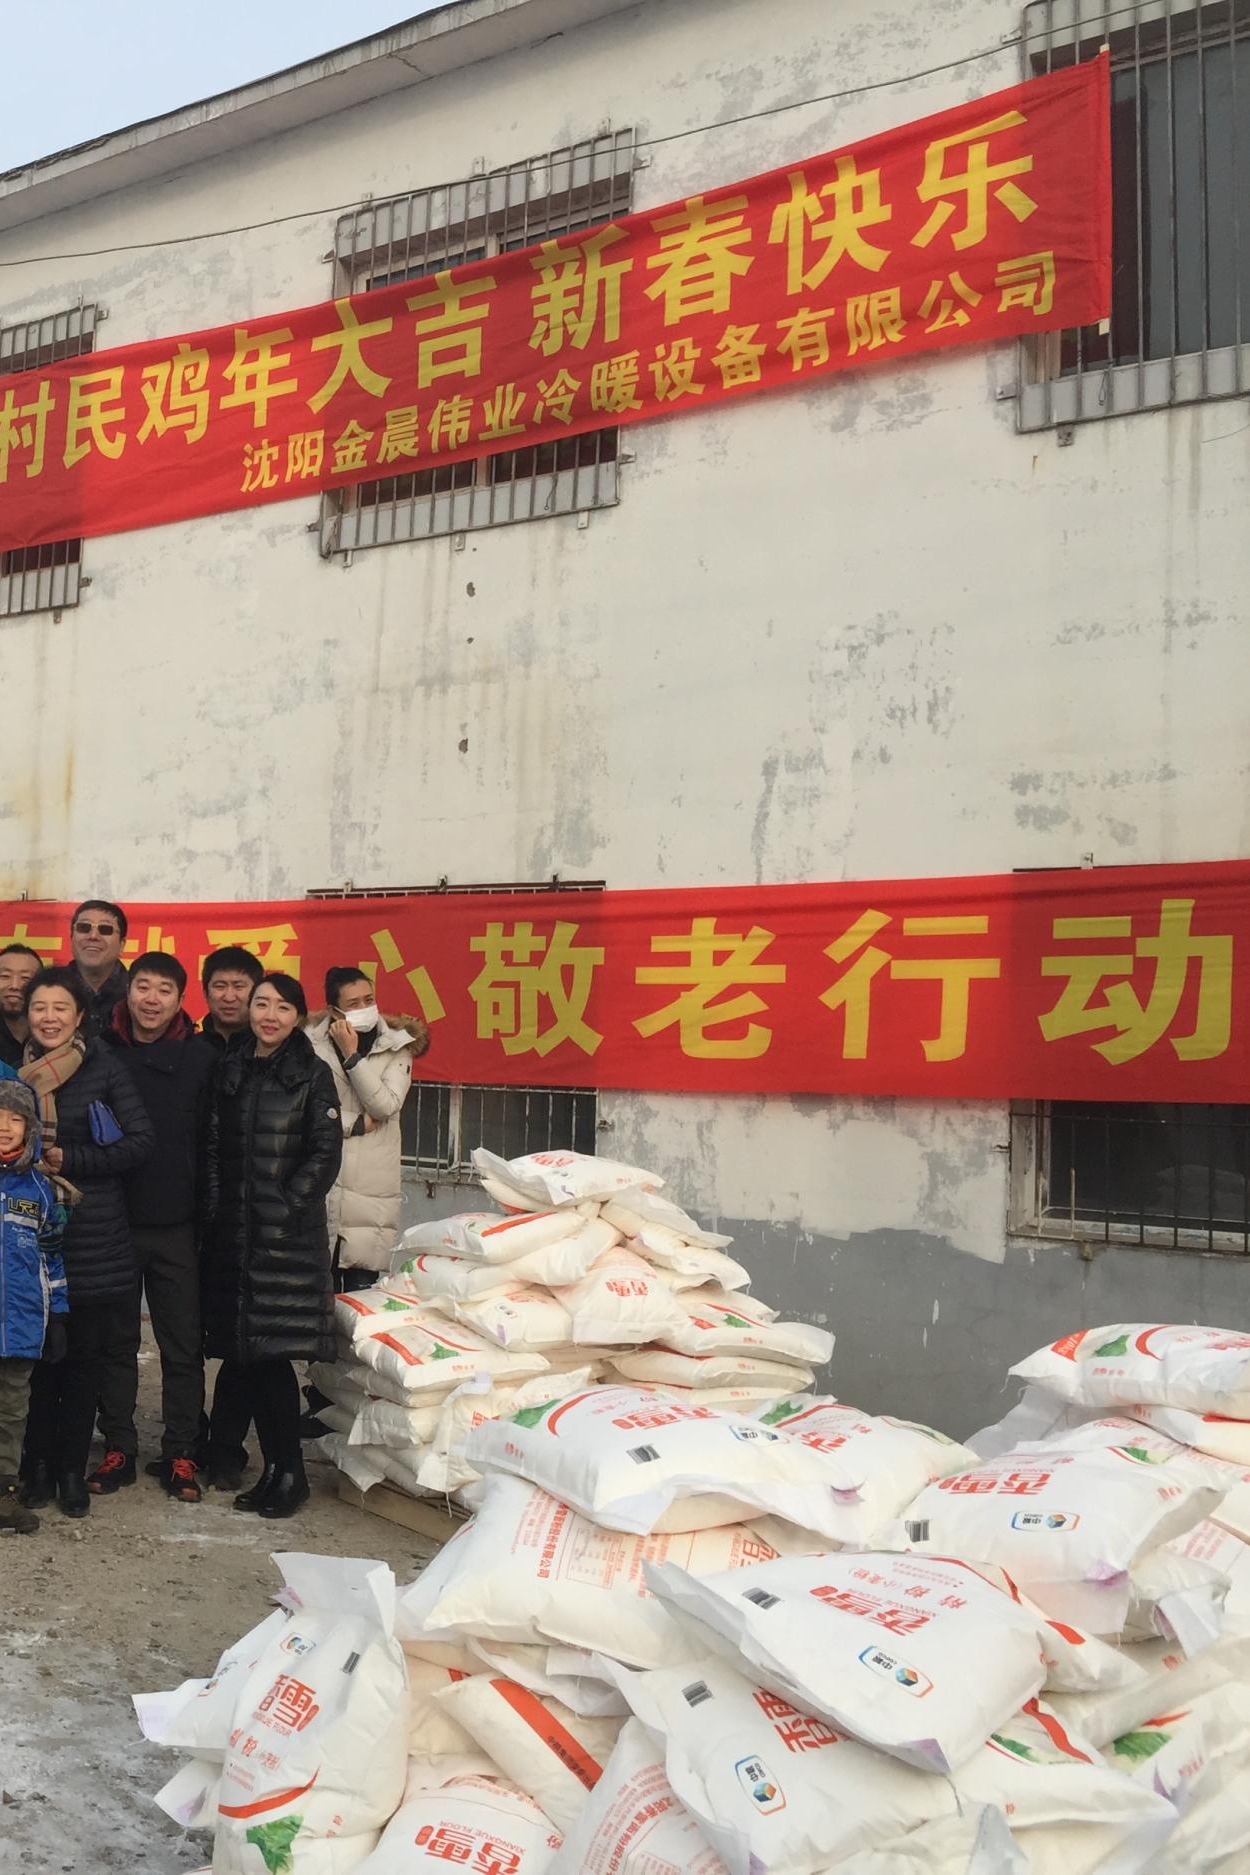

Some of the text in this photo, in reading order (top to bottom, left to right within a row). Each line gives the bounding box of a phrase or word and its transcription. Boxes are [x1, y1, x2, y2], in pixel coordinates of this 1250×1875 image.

[528, 109, 1039, 357] 新春快乐
[240, 250, 1057, 494] 沈阳金晨伟业冷暖设备有限公司
[809, 1585, 931, 1637] 香雪
